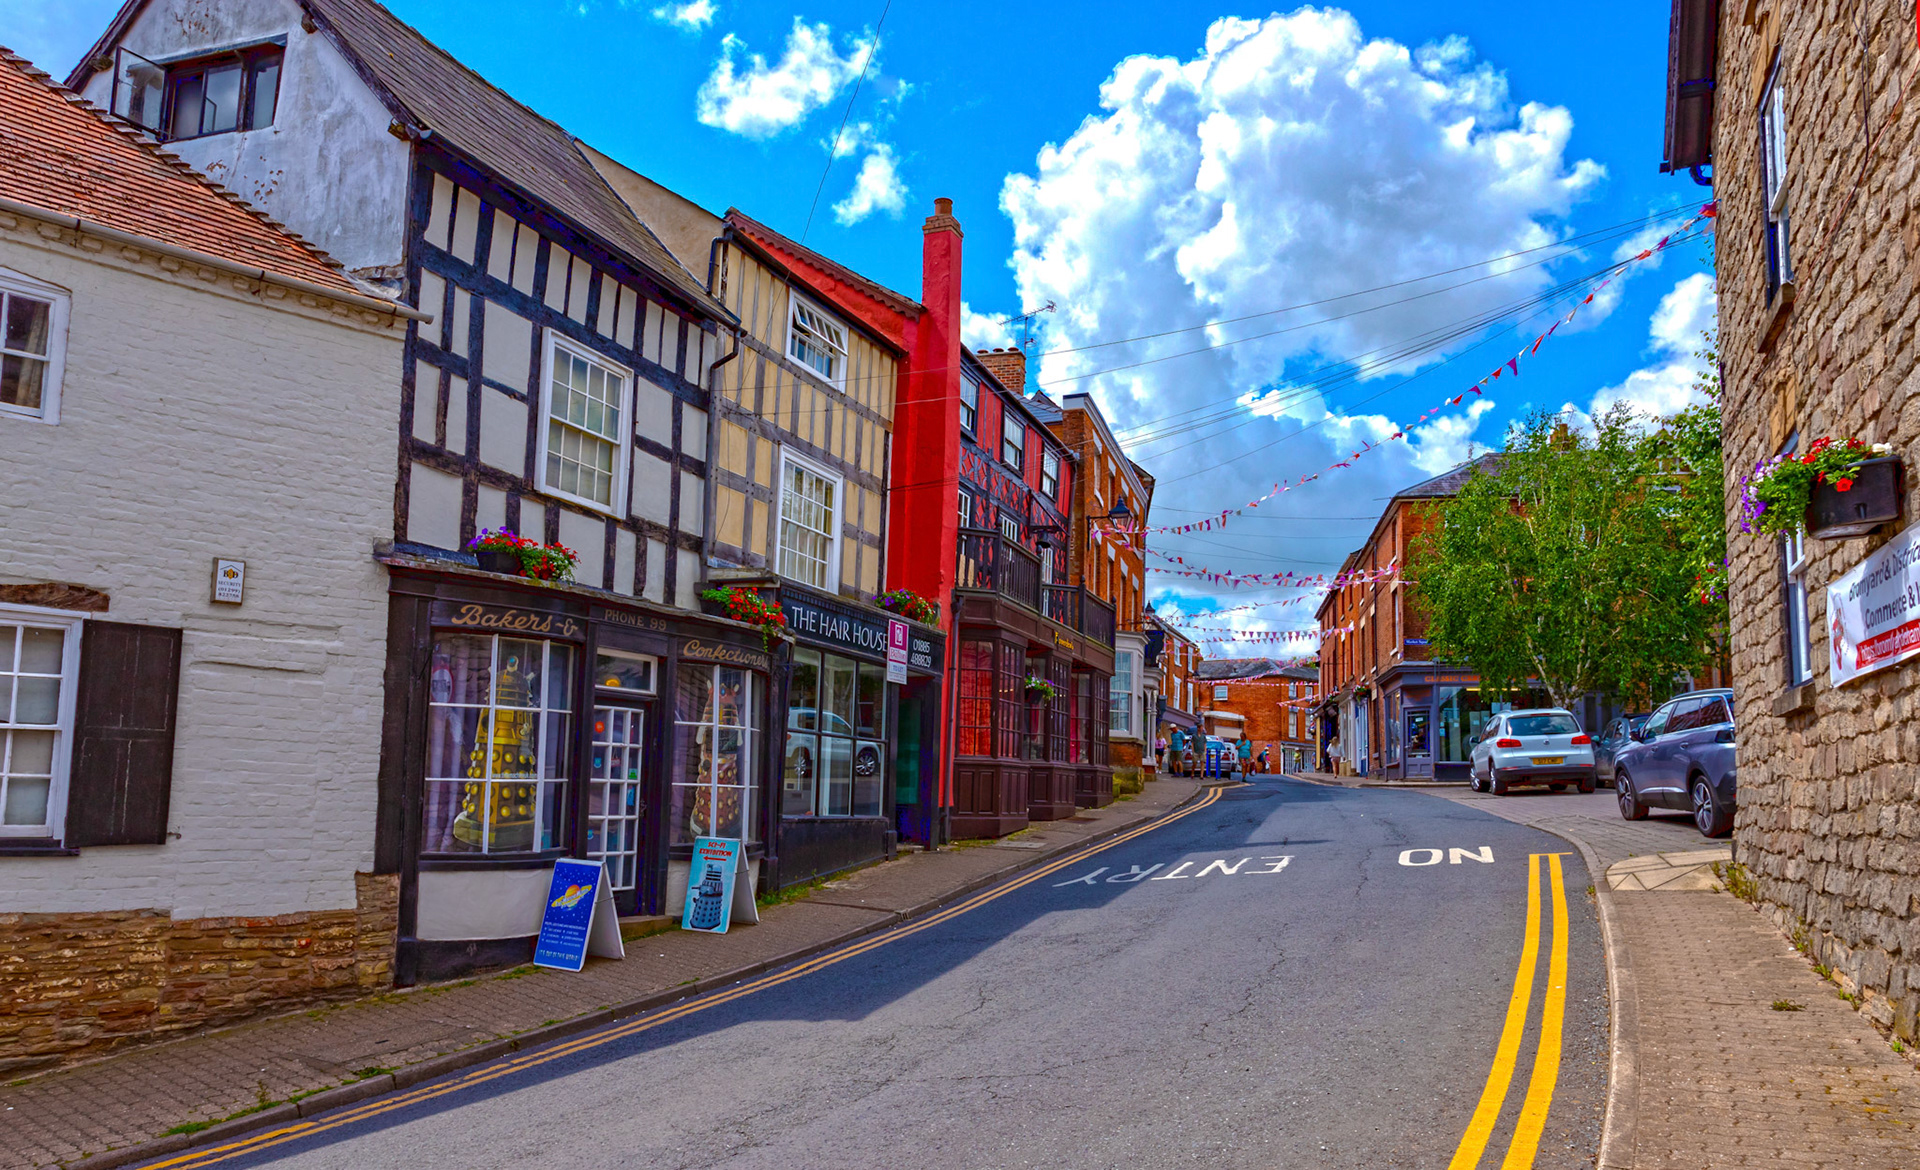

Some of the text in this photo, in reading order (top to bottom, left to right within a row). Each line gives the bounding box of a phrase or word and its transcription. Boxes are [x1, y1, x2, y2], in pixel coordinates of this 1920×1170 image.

[1884, 558, 1892, 581] &
[451, 604, 553, 632] Bakers
[604, 609, 667, 631] PHONE 99
[1865, 594, 1907, 629] Commerce
[1908, 585, 1916, 609] &
[792, 606, 817, 632] THE
[819, 613, 850, 641] HAIR
[853, 623, 888, 652] HOUSE
[683, 639, 769, 669] Confectioners
[707, 841, 727, 849] SCI-FI
[1052, 846, 1495, 887] NO ENTRY
